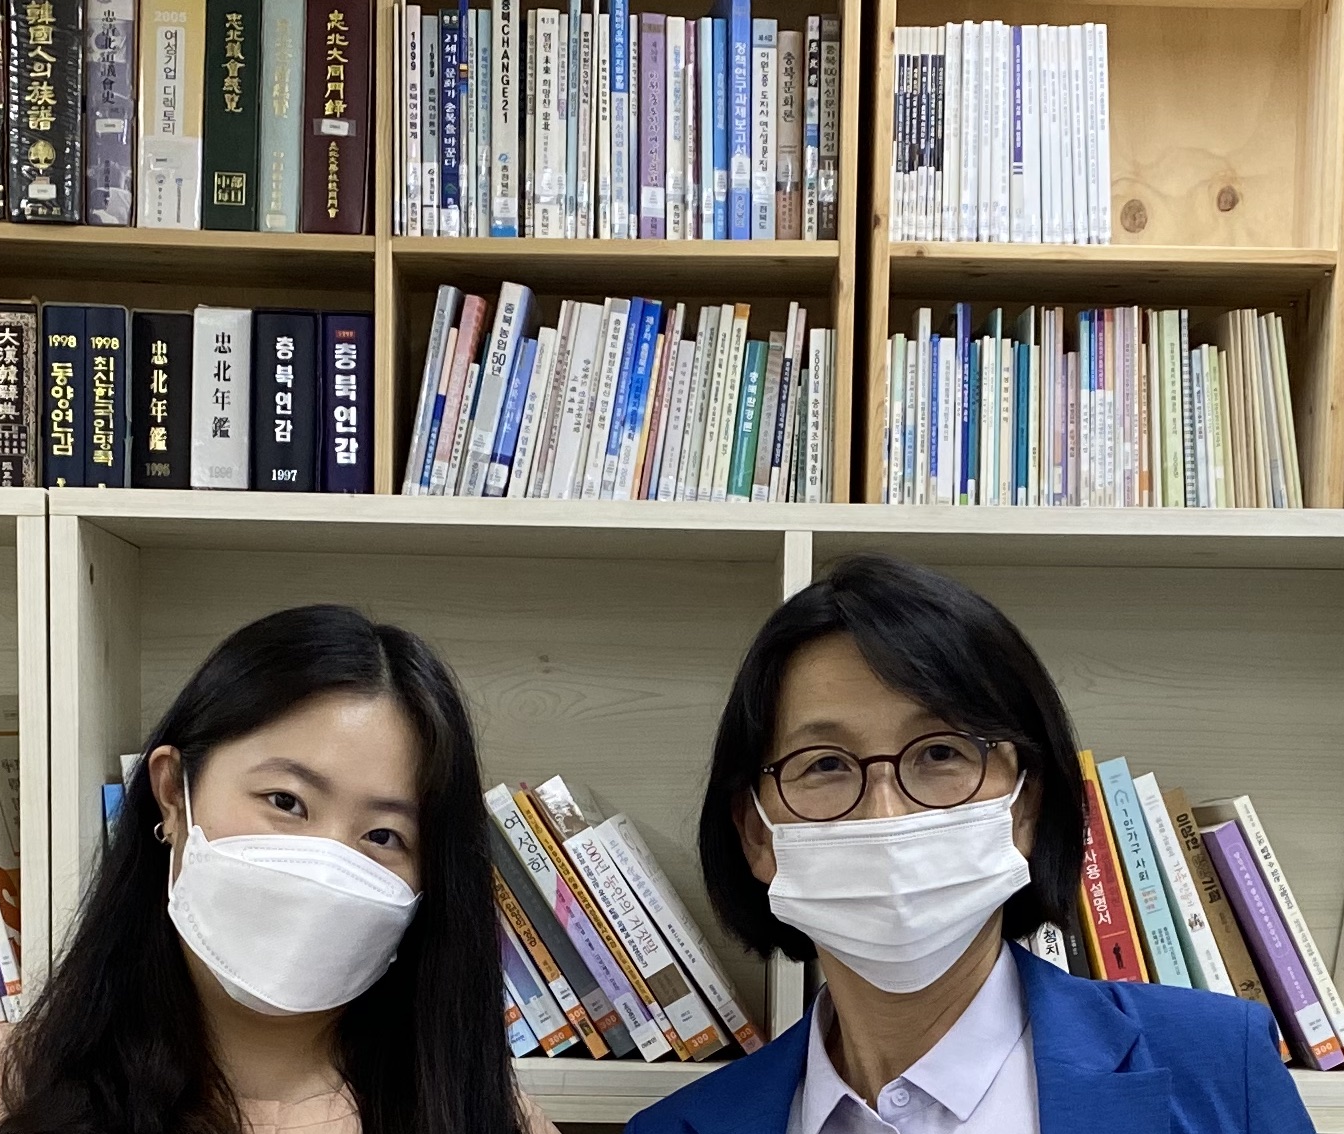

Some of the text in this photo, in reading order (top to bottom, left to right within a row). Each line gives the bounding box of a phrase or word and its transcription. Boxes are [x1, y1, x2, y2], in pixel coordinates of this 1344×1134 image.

[48, 335, 77, 348] 1998
[90, 337, 119, 349] 1998
[274, 336, 294, 443] 충북연감
[334, 343, 358, 464] 충북연감
[51, 362, 74, 456] 동양연감
[272, 469, 297, 481] 1997
[1176, 813, 1200, 851] 이상한
[1136, 859, 1150, 881] 사회
[1090, 882, 1112, 925] 설명서
[628, 918, 658, 956] 거짓말
